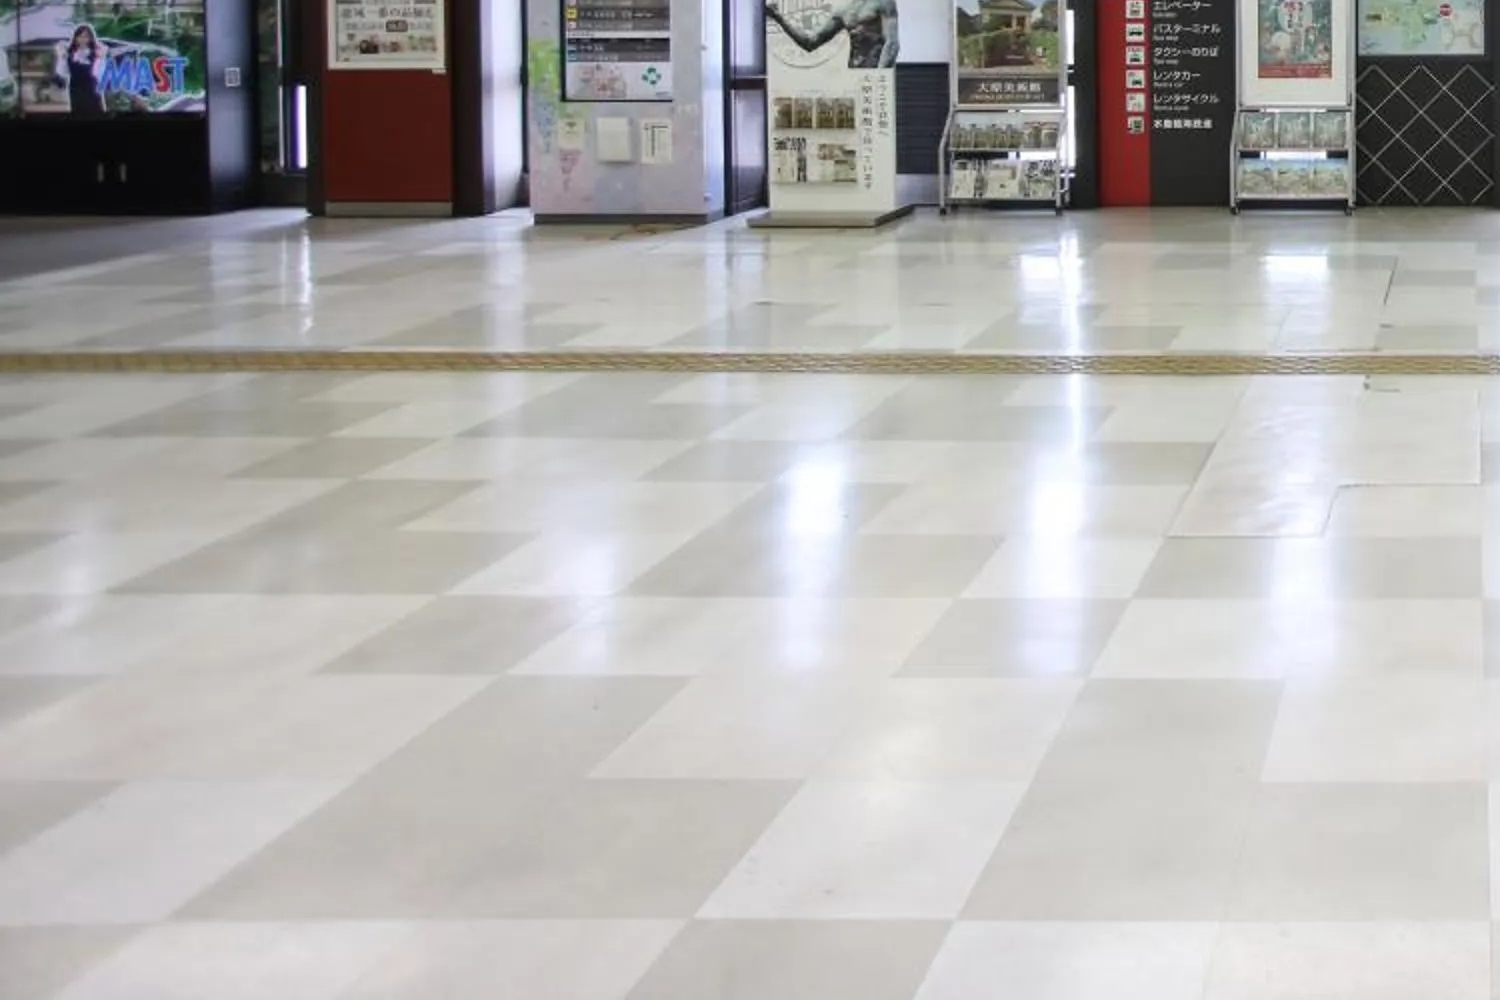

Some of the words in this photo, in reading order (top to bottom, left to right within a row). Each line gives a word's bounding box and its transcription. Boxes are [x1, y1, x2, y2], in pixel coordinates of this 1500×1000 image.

[97, 55, 189, 95] MAST
[1153, 70, 1201, 80] レンタカー
[1153, 93, 1219, 104] レンタサイクル
